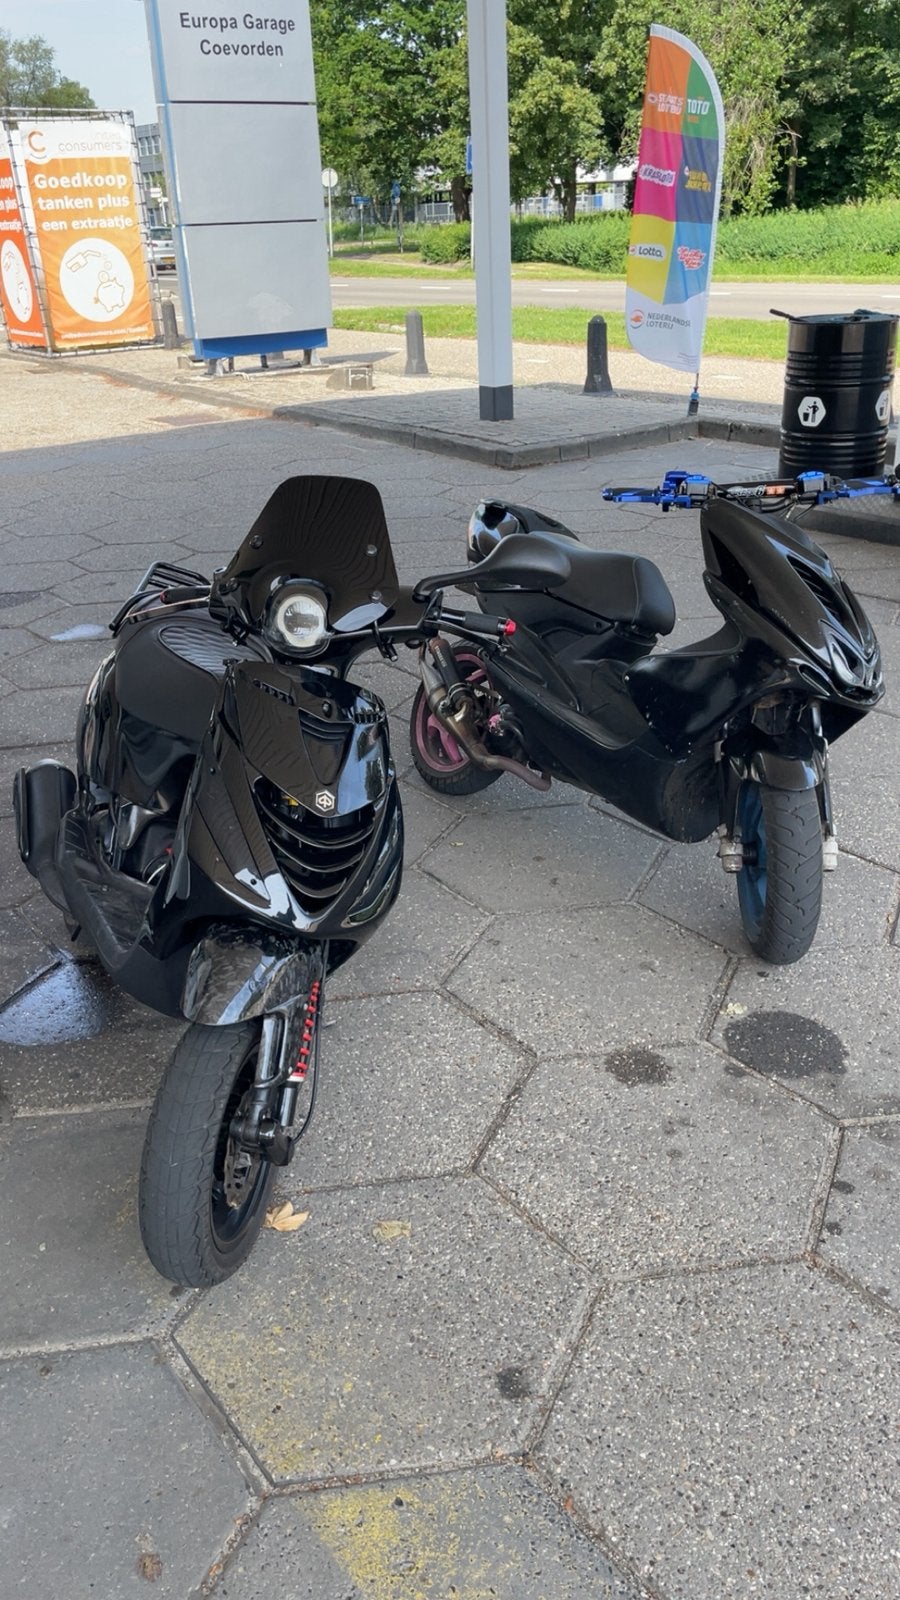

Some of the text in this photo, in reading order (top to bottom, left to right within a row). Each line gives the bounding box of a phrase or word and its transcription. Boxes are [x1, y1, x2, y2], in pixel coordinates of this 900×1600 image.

[179, 12, 295, 34] Europa Garage
[200, 39, 284, 56] Coevorden
[687, 99, 710, 115] TOTO
[58, 142, 122, 152] consumers
[34, 172, 127, 189] Goedkoop
[38, 194, 129, 210] tanken plus
[42, 215, 133, 231] een extraatje
[646, 320, 674, 330] LOTERIJ
